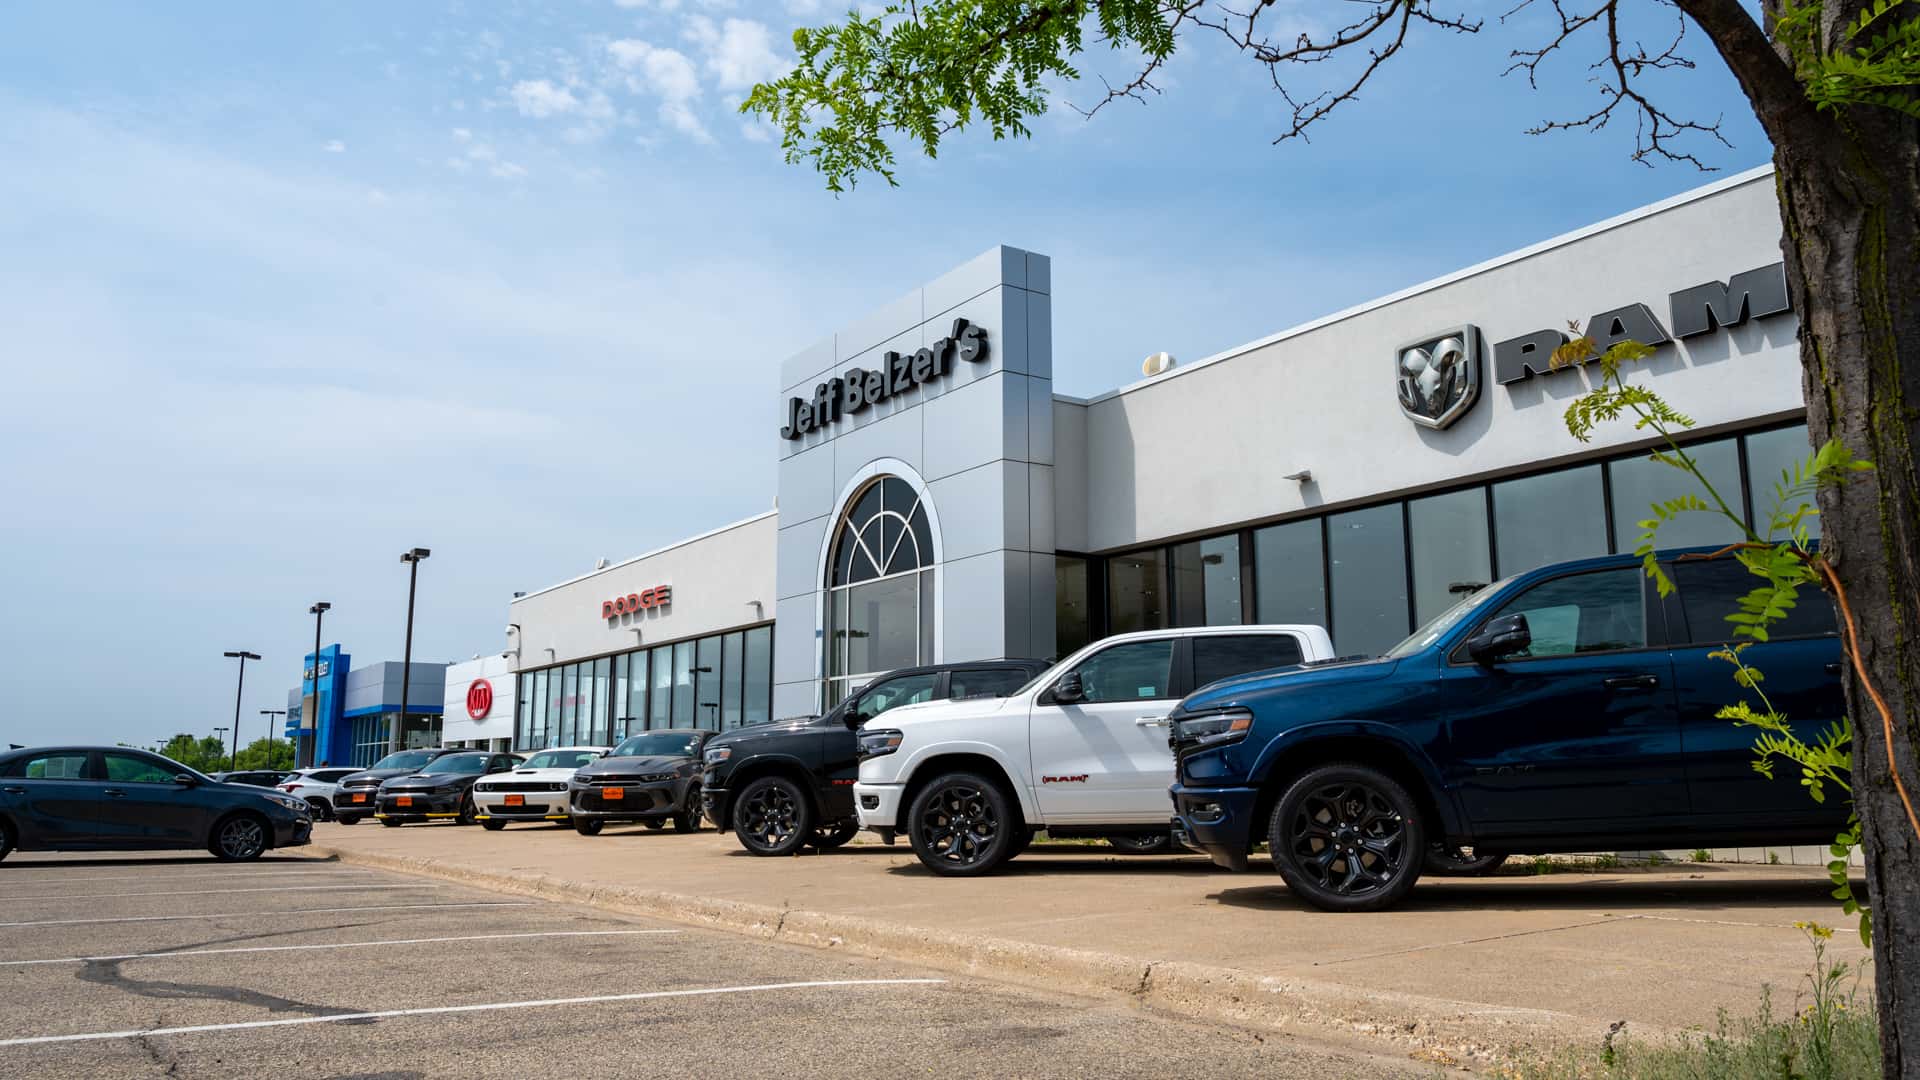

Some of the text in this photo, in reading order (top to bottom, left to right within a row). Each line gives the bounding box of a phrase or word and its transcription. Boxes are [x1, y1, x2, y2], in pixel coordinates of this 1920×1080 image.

[781, 317, 990, 440] Jeff Belzer's
[1493, 262, 1791, 386] RAM
[601, 584, 672, 619] DODGE
